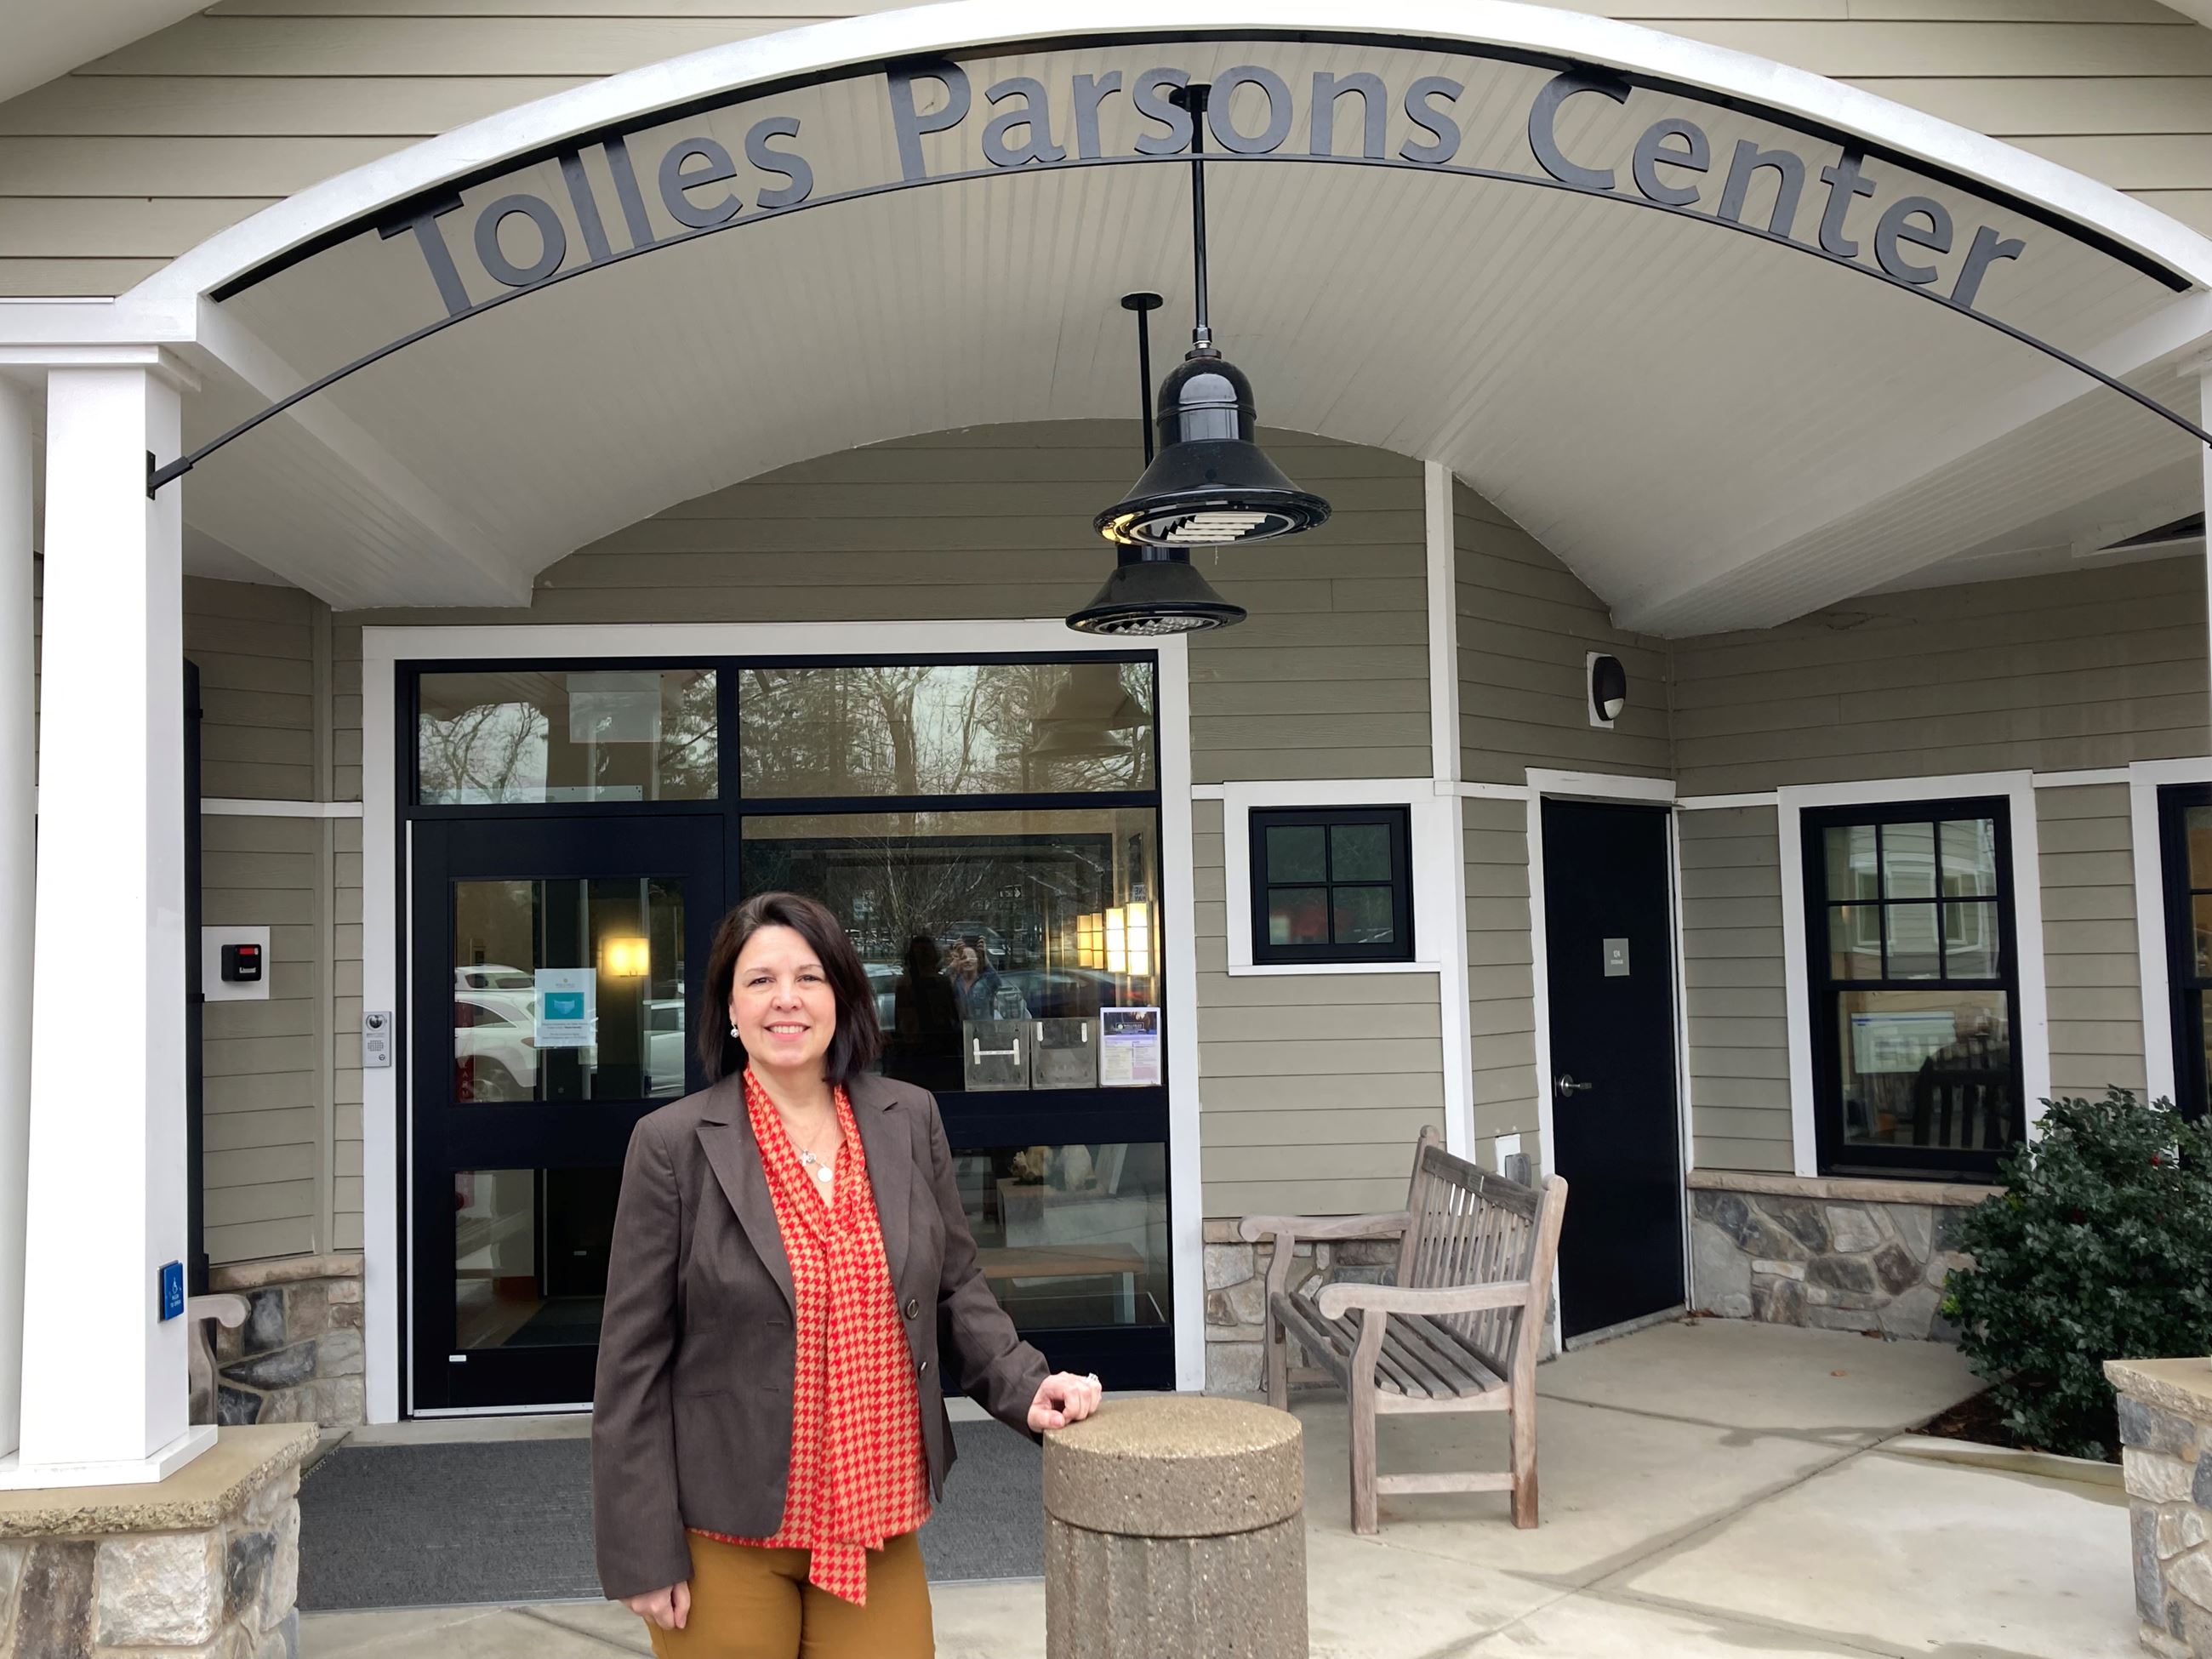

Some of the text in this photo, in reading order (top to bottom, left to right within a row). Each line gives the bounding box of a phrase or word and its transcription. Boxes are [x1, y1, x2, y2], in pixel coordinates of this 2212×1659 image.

[379, 57, 2027, 317] Tolles Parsons Center
